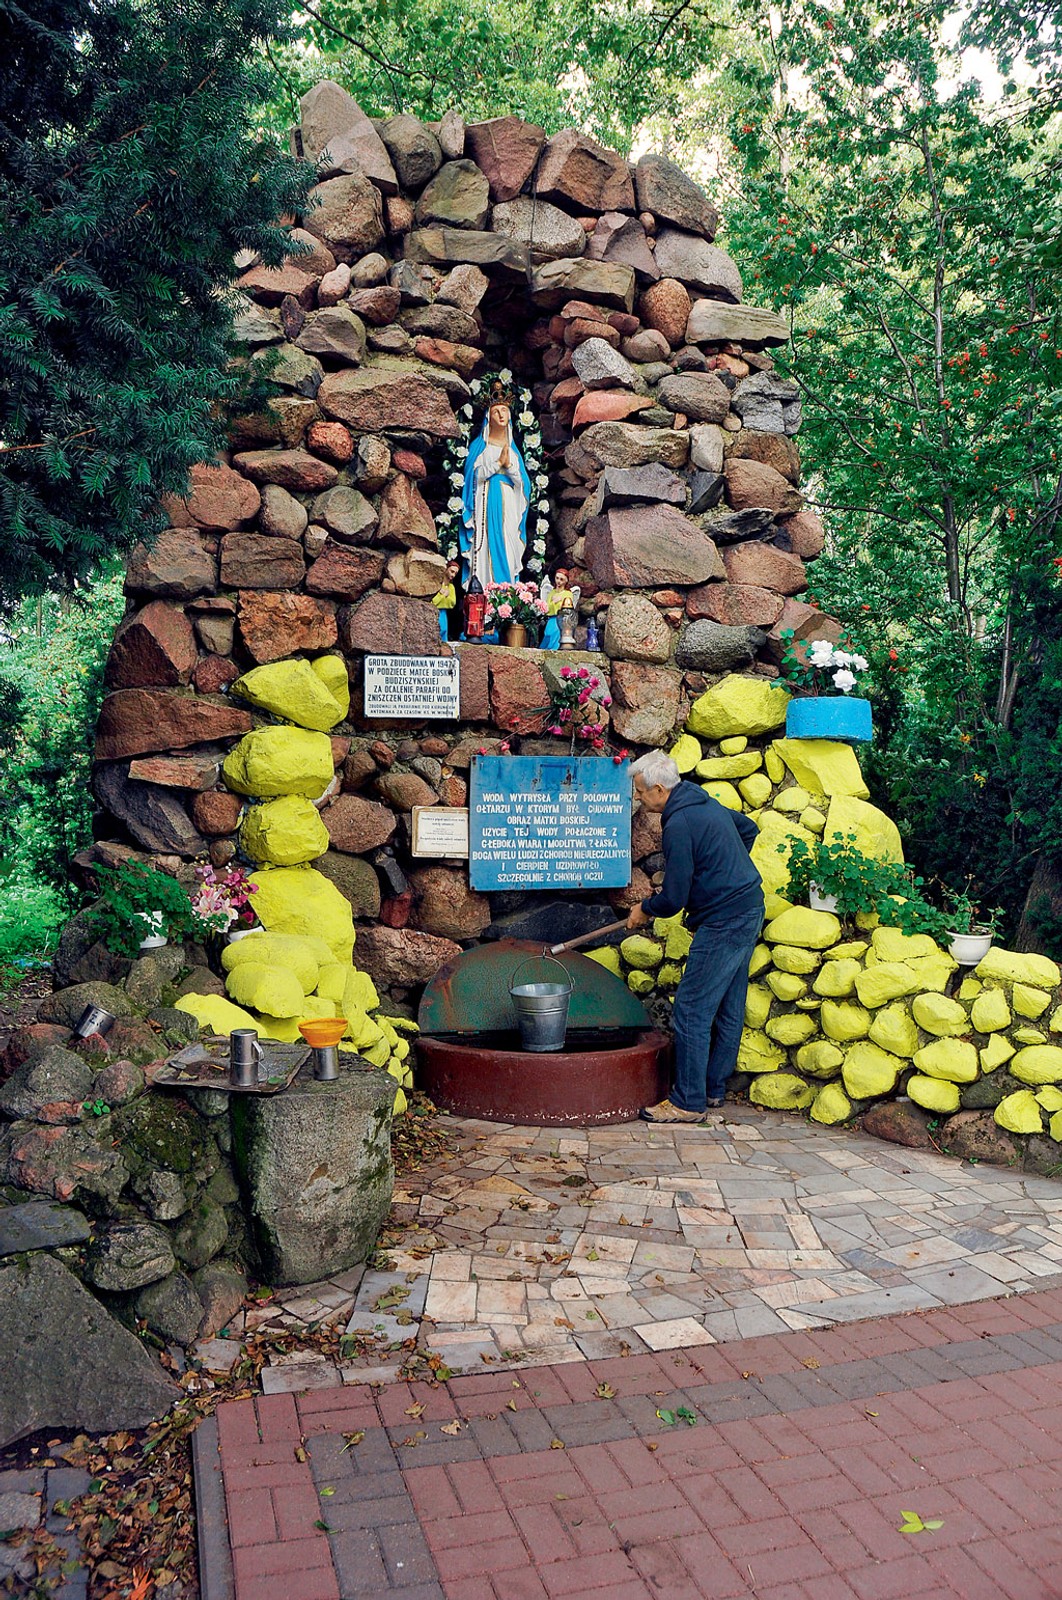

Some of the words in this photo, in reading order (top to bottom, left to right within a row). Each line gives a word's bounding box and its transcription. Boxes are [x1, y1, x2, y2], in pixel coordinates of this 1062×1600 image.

[368, 658, 387, 667] GROTA
[390, 659, 428, 668] ZBUDOWANA
[430, 660, 435, 668] W
[368, 667, 374, 675] W
[374, 685, 382, 693] ZA
[385, 685, 413, 694] OCALENIE
[416, 686, 440, 694] PARAFII
[442, 686, 451, 694] OD
[404, 694, 434, 702] OSTATNIEJ
[437, 694, 457, 702] WOJNY
[482, 793, 504, 802] WODA
[510, 793, 551, 802] WYTRYSŁA
[559, 793, 577, 802] PRZY
[583, 793, 620, 802] POLOWYM
[476, 804, 510, 813] OŁTARZU
[515, 804, 523, 813] W
[566, 805, 580, 813] BYŁ
[588, 805, 623, 813] CUDOWNY
[507, 816, 531, 824] OBRAZ
[533, 816, 556, 824] MATKI
[514, 827, 529, 836] TEJ
[537, 827, 558, 836] WODY
[612, 827, 617, 836] Z
[543, 839, 546, 848] I
[589, 839, 593, 848] Z
[472, 850, 492, 860] BOGA
[493, 850, 516, 860] WIELU
[518, 850, 538, 860] LUDZI
[540, 850, 544, 859] Z
[574, 849, 631, 859] NIEULECZALNYCH
[502, 862, 505, 871] I
[547, 873, 551, 882] Z
